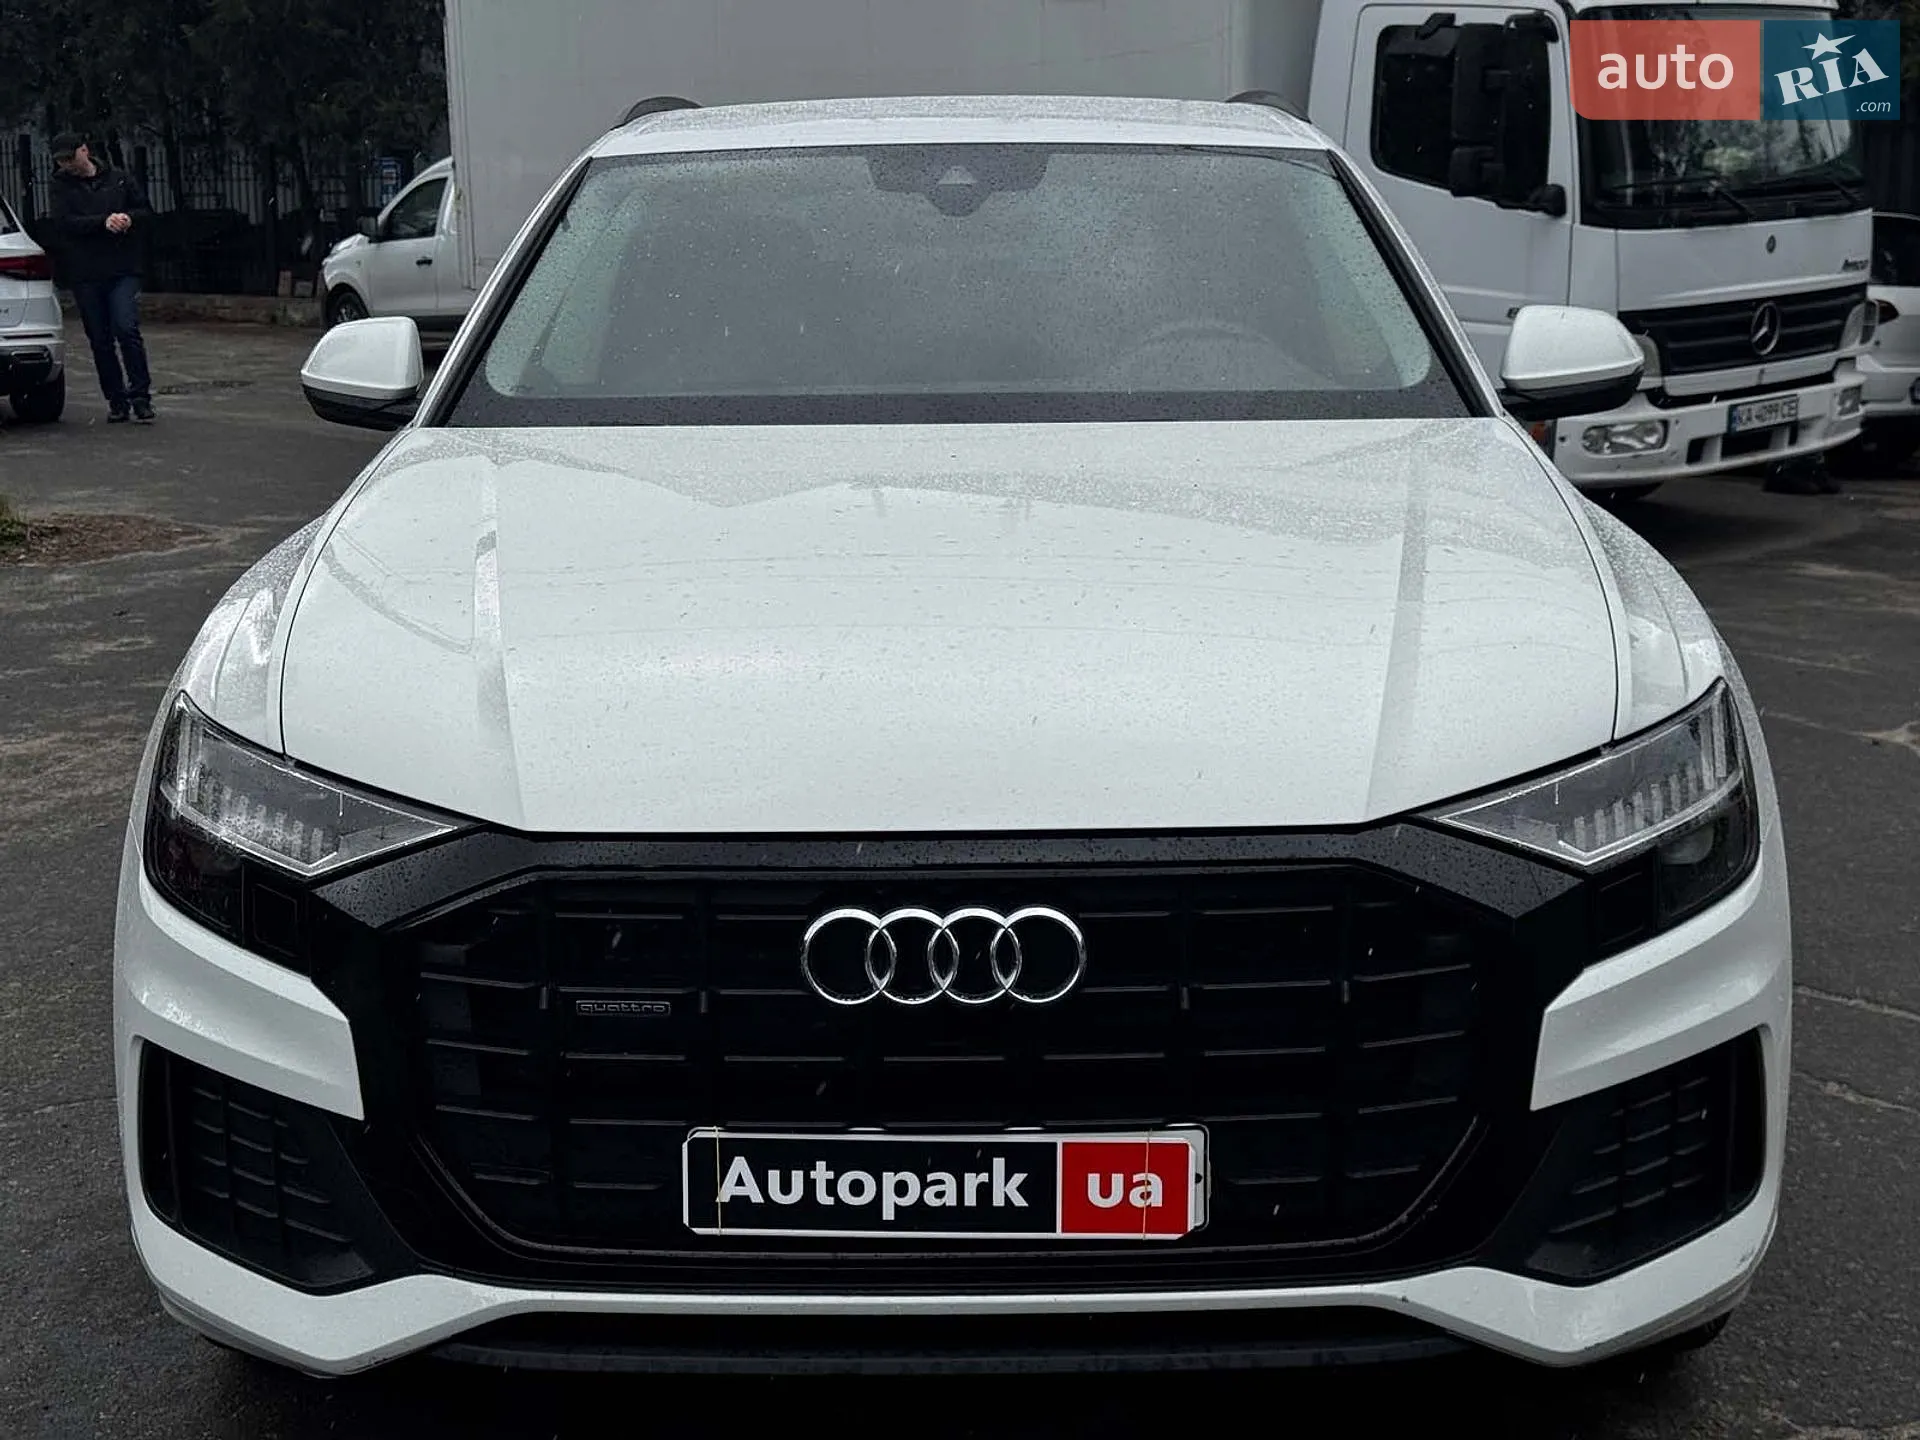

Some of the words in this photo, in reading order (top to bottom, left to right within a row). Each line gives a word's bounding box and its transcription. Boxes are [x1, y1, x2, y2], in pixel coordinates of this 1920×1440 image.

[580, 1003, 665, 1014] quattro
[716, 1155, 1029, 1221] Autopark
[1086, 1171, 1164, 1209] ua
